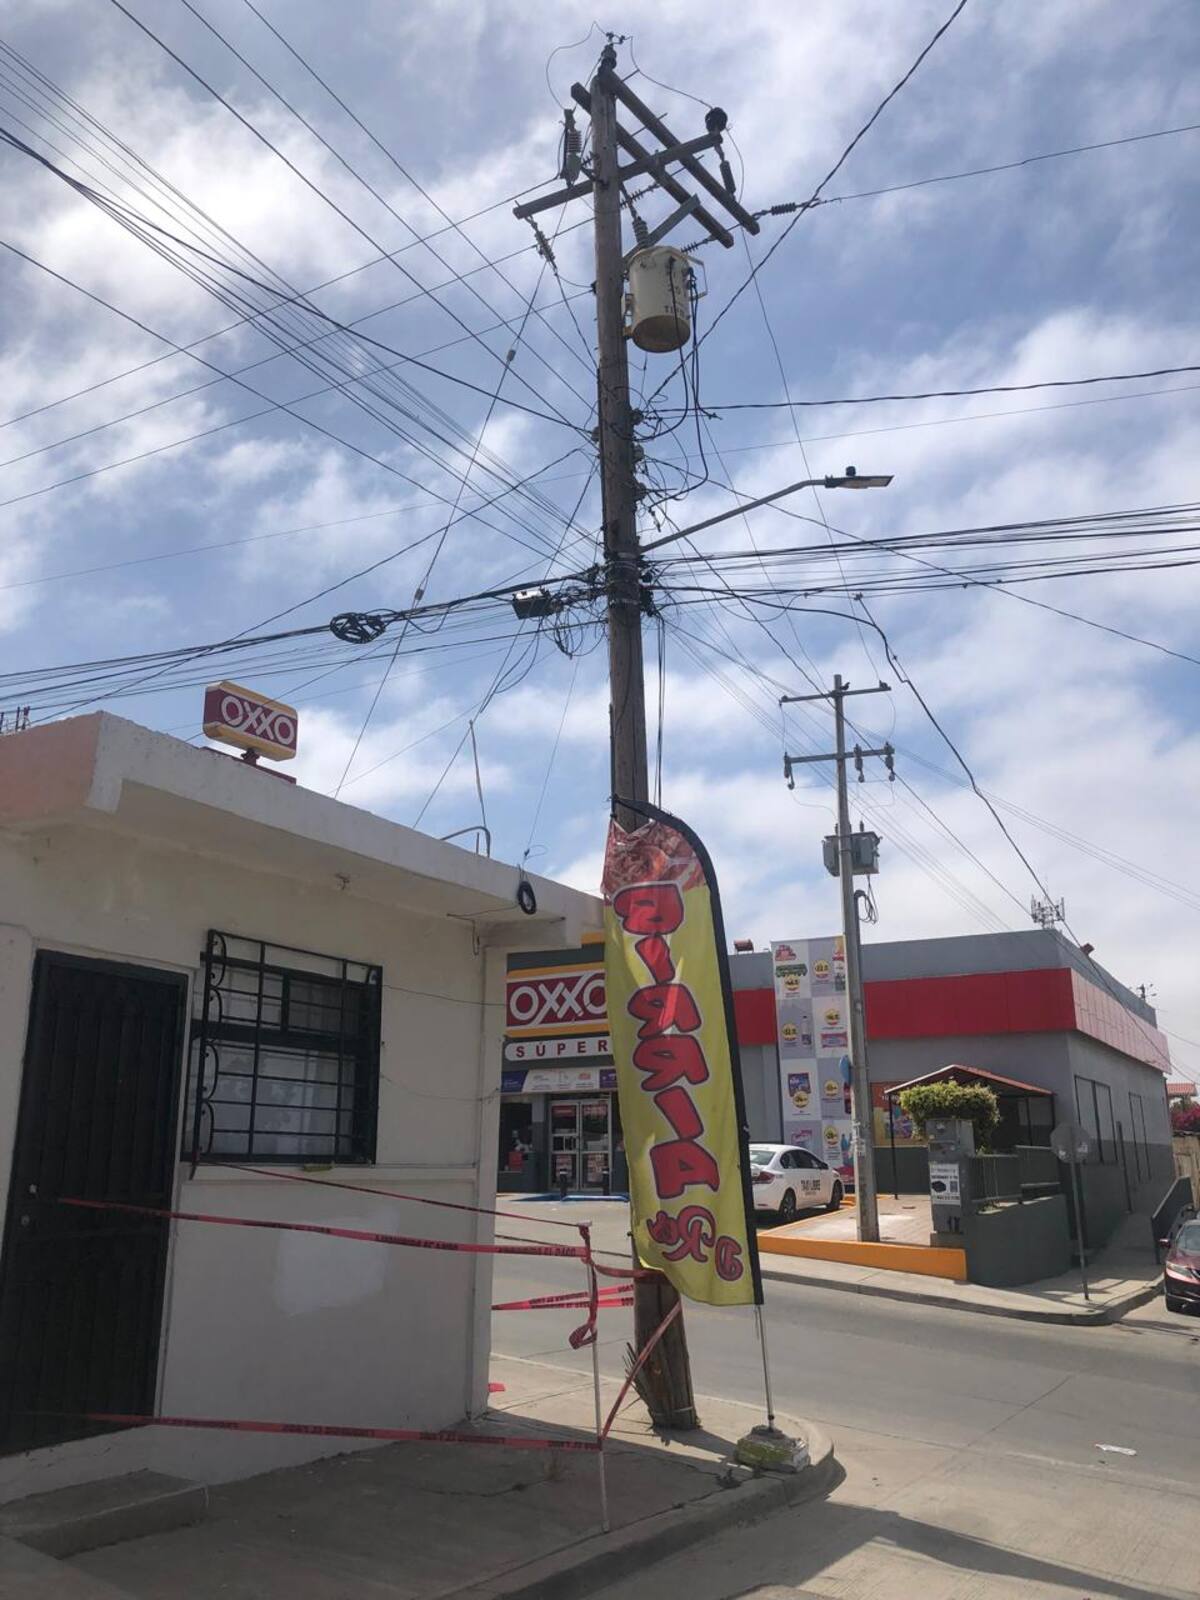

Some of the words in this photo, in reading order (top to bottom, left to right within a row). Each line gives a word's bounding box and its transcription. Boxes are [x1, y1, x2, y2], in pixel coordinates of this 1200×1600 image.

[221, 696, 295, 745] OXXO
[509, 973, 607, 1025] OXXO
[515, 1040, 608, 1058] SÚPER
